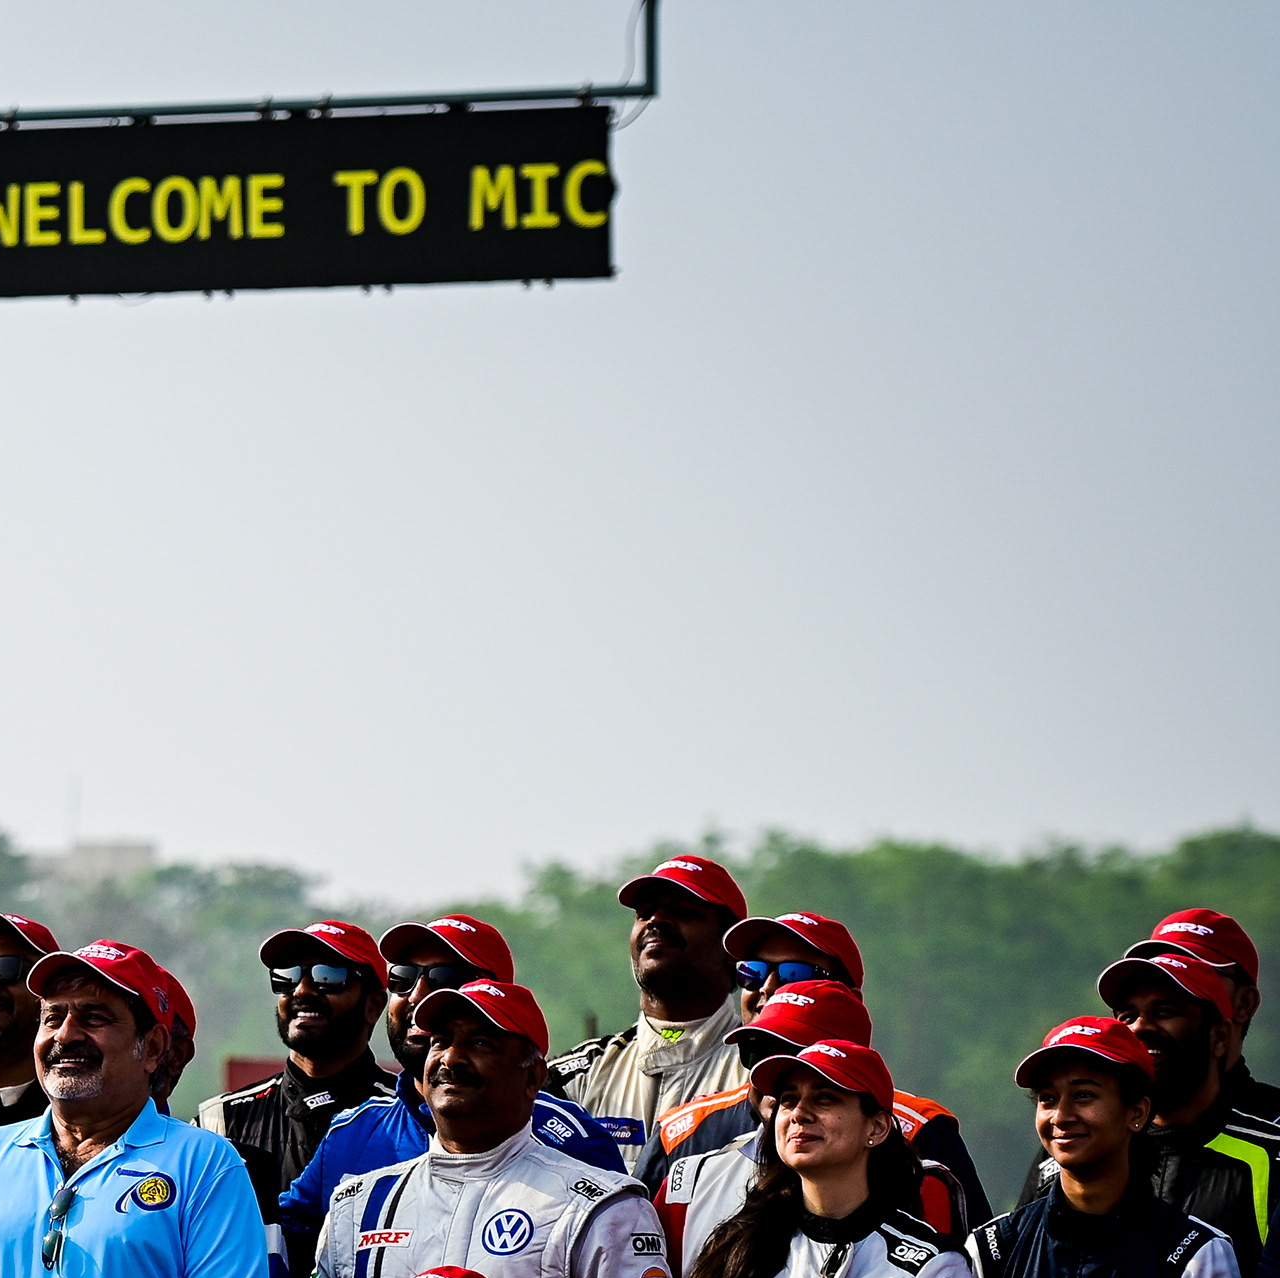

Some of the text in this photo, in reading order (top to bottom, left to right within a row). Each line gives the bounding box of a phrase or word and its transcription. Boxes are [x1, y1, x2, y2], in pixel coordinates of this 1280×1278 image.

[332, 167, 427, 235] TO
[469, 160, 610, 230] MIC
[558, 1058, 589, 1072] OMP
[305, 1094, 333, 1107] OMP
[547, 1117, 572, 1138] OMP
[666, 1115, 694, 1136] OMP
[335, 1181, 363, 1202] OMP
[573, 1181, 602, 1199] OMP
[359, 1231, 409, 1247] MRF
[894, 1246, 929, 1263] OMP
